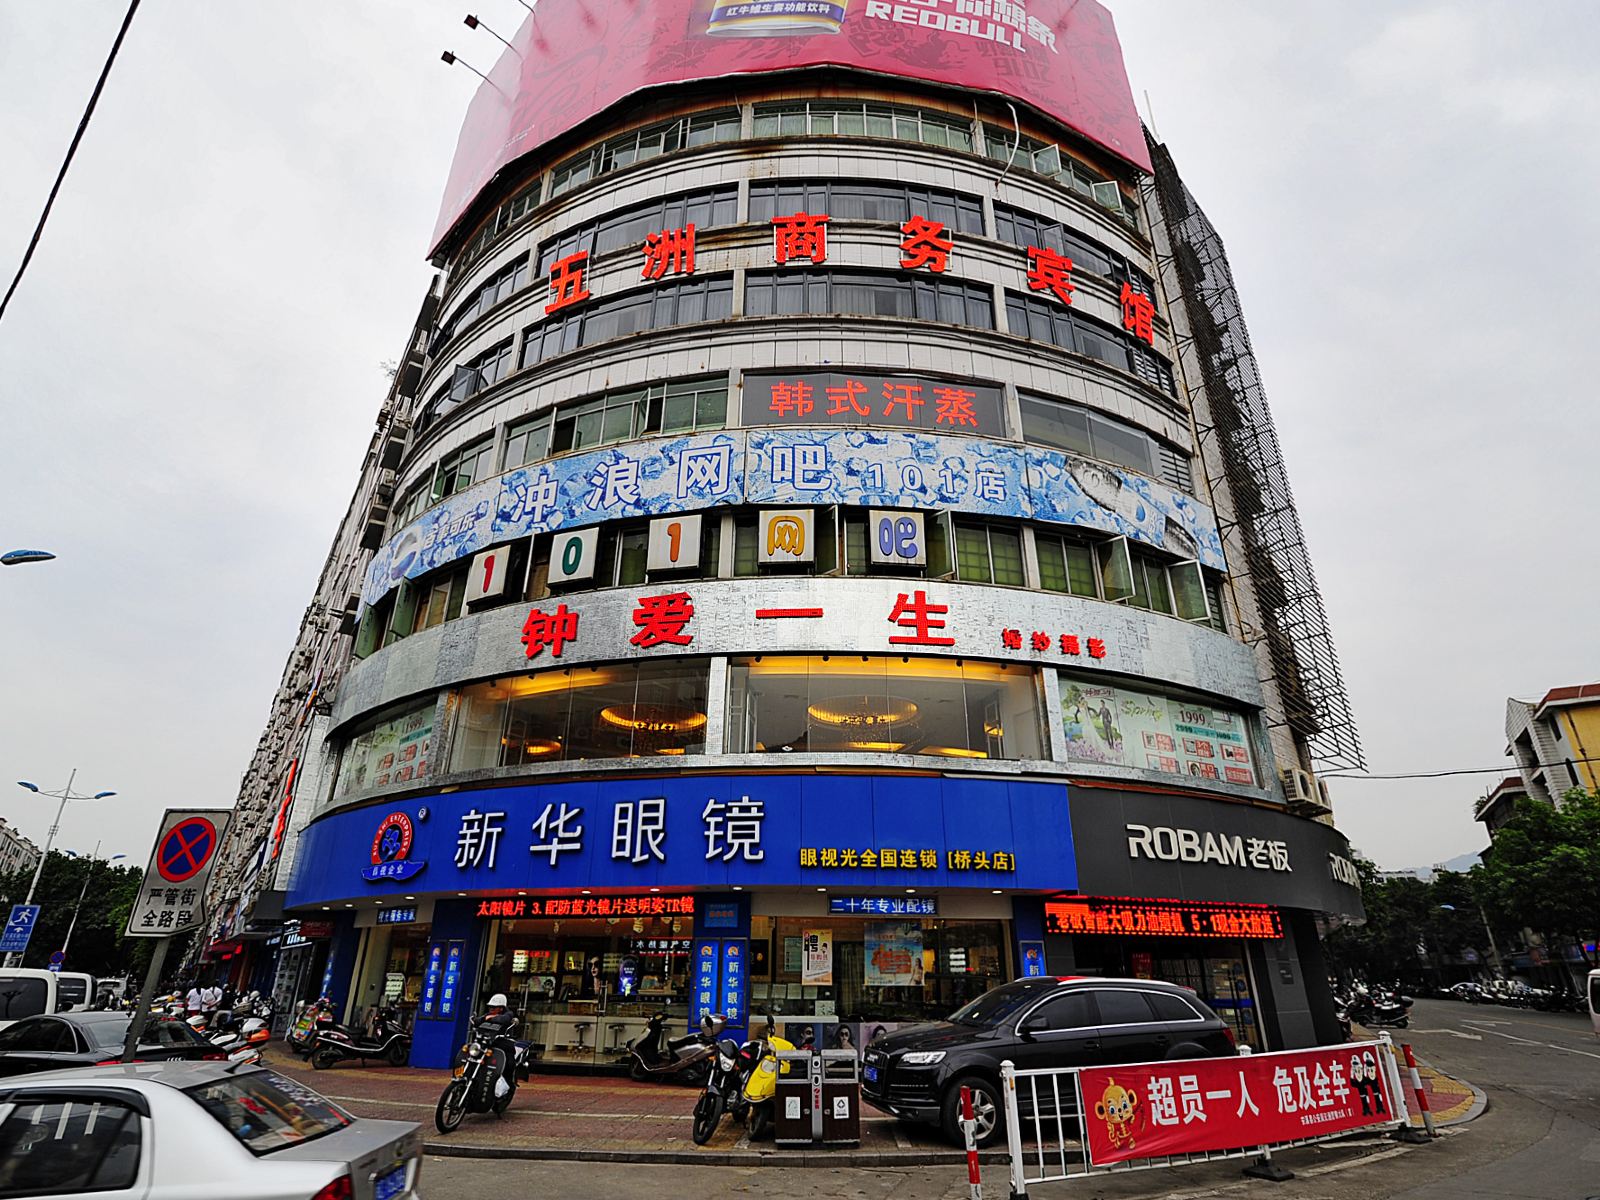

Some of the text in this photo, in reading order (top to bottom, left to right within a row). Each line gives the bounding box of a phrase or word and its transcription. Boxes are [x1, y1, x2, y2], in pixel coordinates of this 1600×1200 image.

[865, 0, 1026, 53] REDBULL
[545, 211, 1155, 346] 五洲商务宾馆
[769, 379, 978, 427] 韩式汗蒸
[520, 590, 956, 660] 钟爱一生
[1001, 627, 1107, 659] 婚纱摄影
[1180, 710, 1206, 725] 1999
[453, 795, 765, 868] 新华眼镜
[799, 847, 938, 869] 眼视光全国连锁
[141, 909, 194, 928] 全路段
[146, 888, 197, 906] 严管街
[831, 897, 936, 914] 二十年专业配镜
[727, 961, 739, 1019] 新华眼镜
[1146, 1059, 1351, 1127] 超员一人 危及全车
